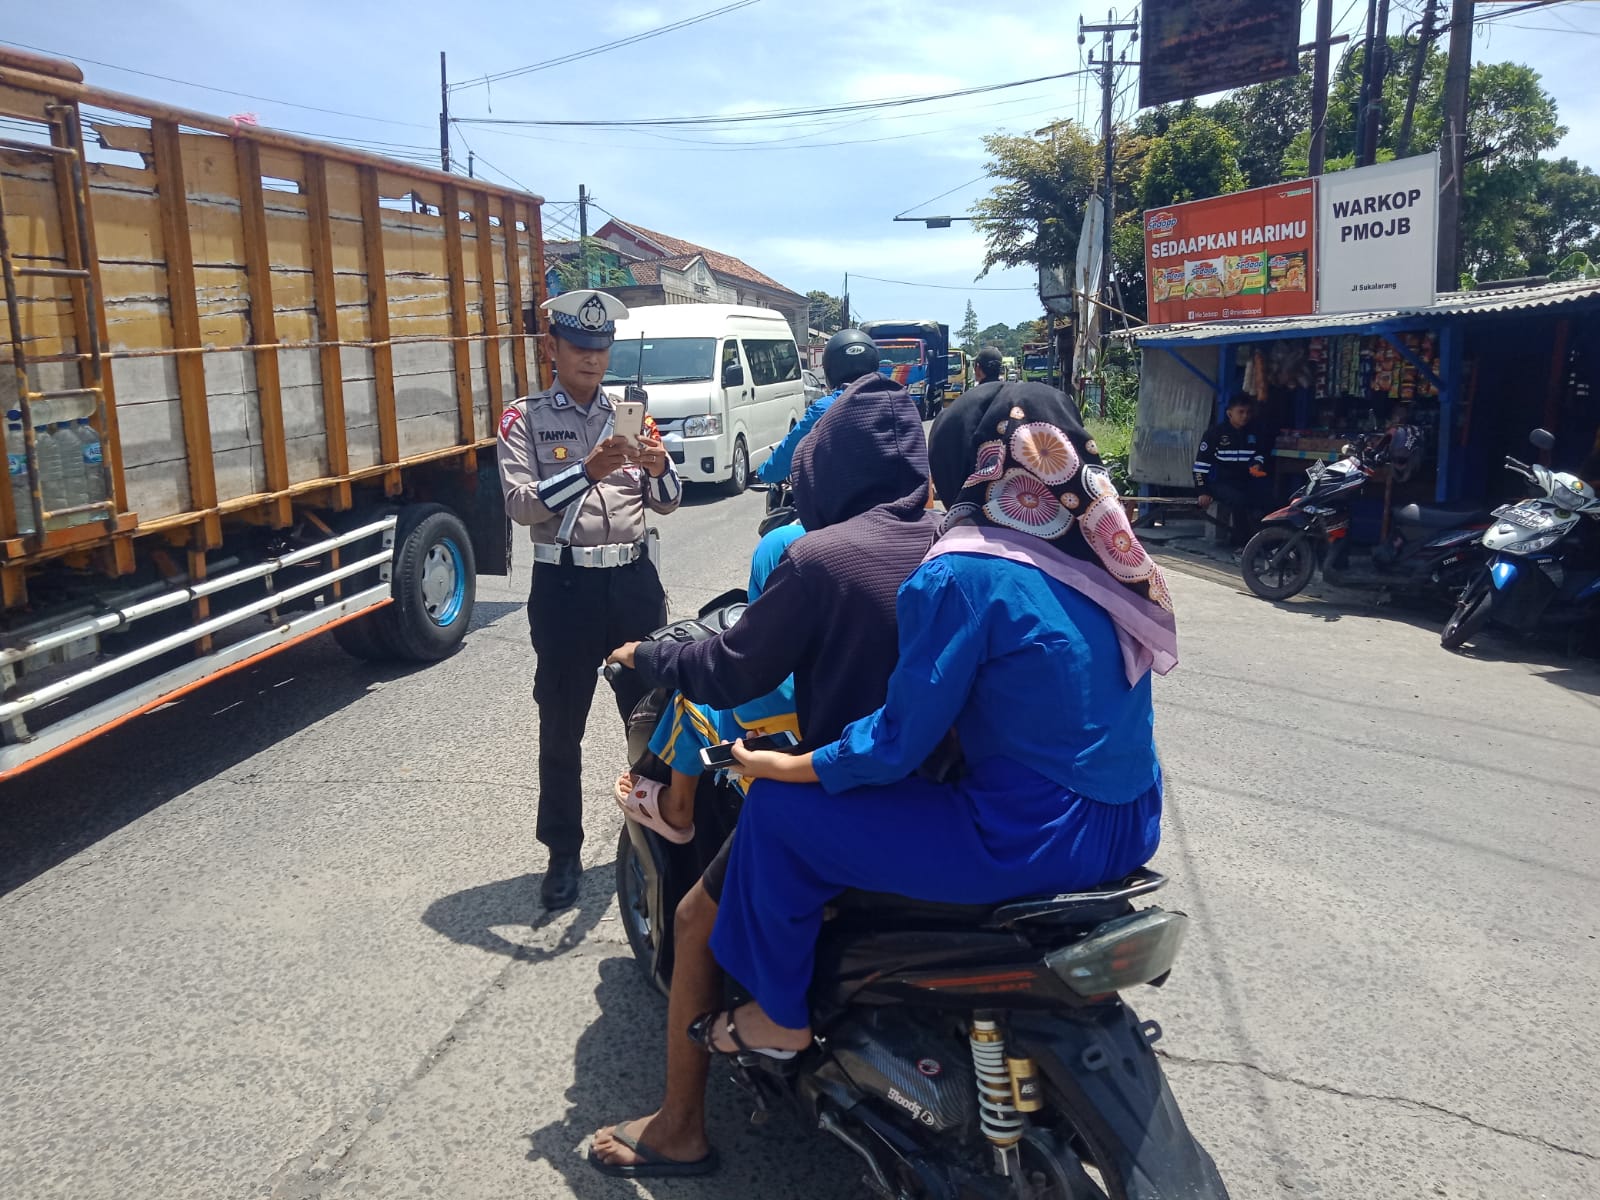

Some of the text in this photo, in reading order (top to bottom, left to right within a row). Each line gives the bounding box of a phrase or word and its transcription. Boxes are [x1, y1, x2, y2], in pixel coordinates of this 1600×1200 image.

[1333, 189, 1421, 219] WARKOP
[1152, 220, 1306, 259] SEDAAPKAN HARIMU
[1341, 217, 1411, 242] PMOJB
[537, 430, 578, 441] TAHYAR
